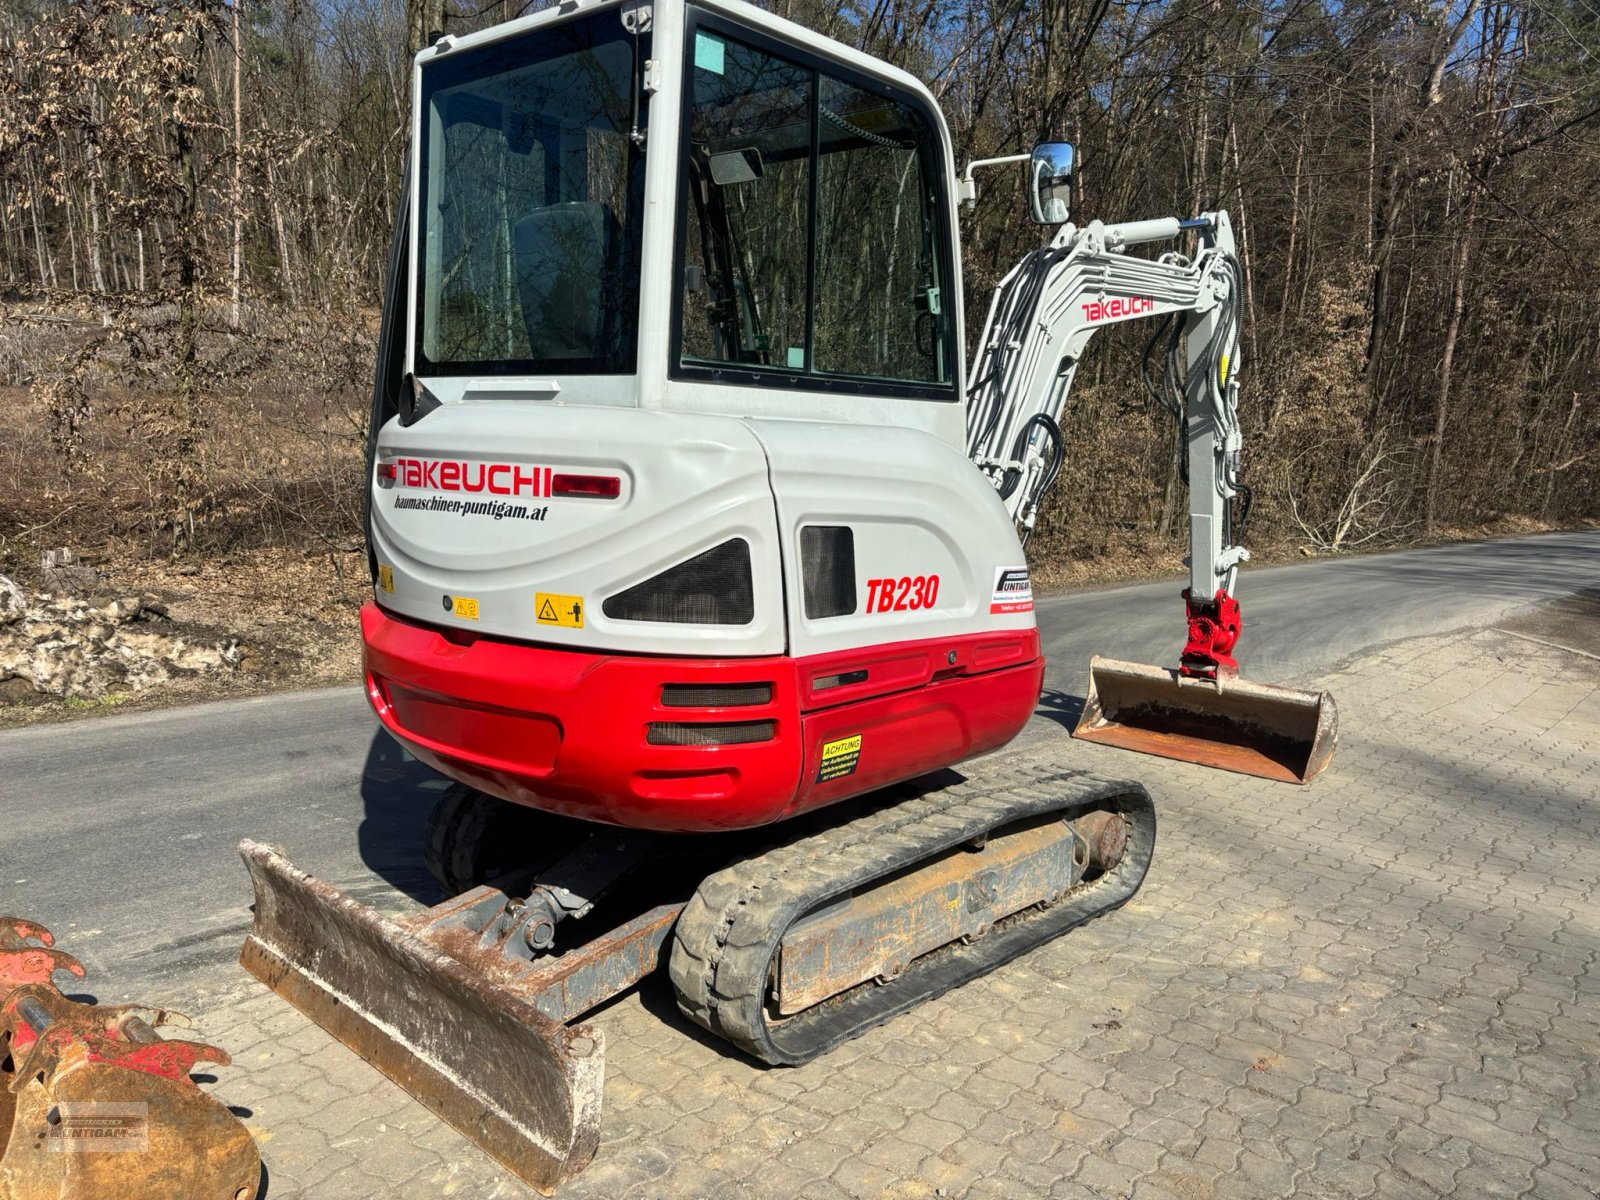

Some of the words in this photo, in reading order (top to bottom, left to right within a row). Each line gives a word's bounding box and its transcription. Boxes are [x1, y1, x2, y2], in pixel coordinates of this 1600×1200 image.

[394, 494, 549, 521] baumaschinen-puntigam.at
[866, 575, 940, 614] TB230
[824, 739, 860, 756] ACHTUNG
